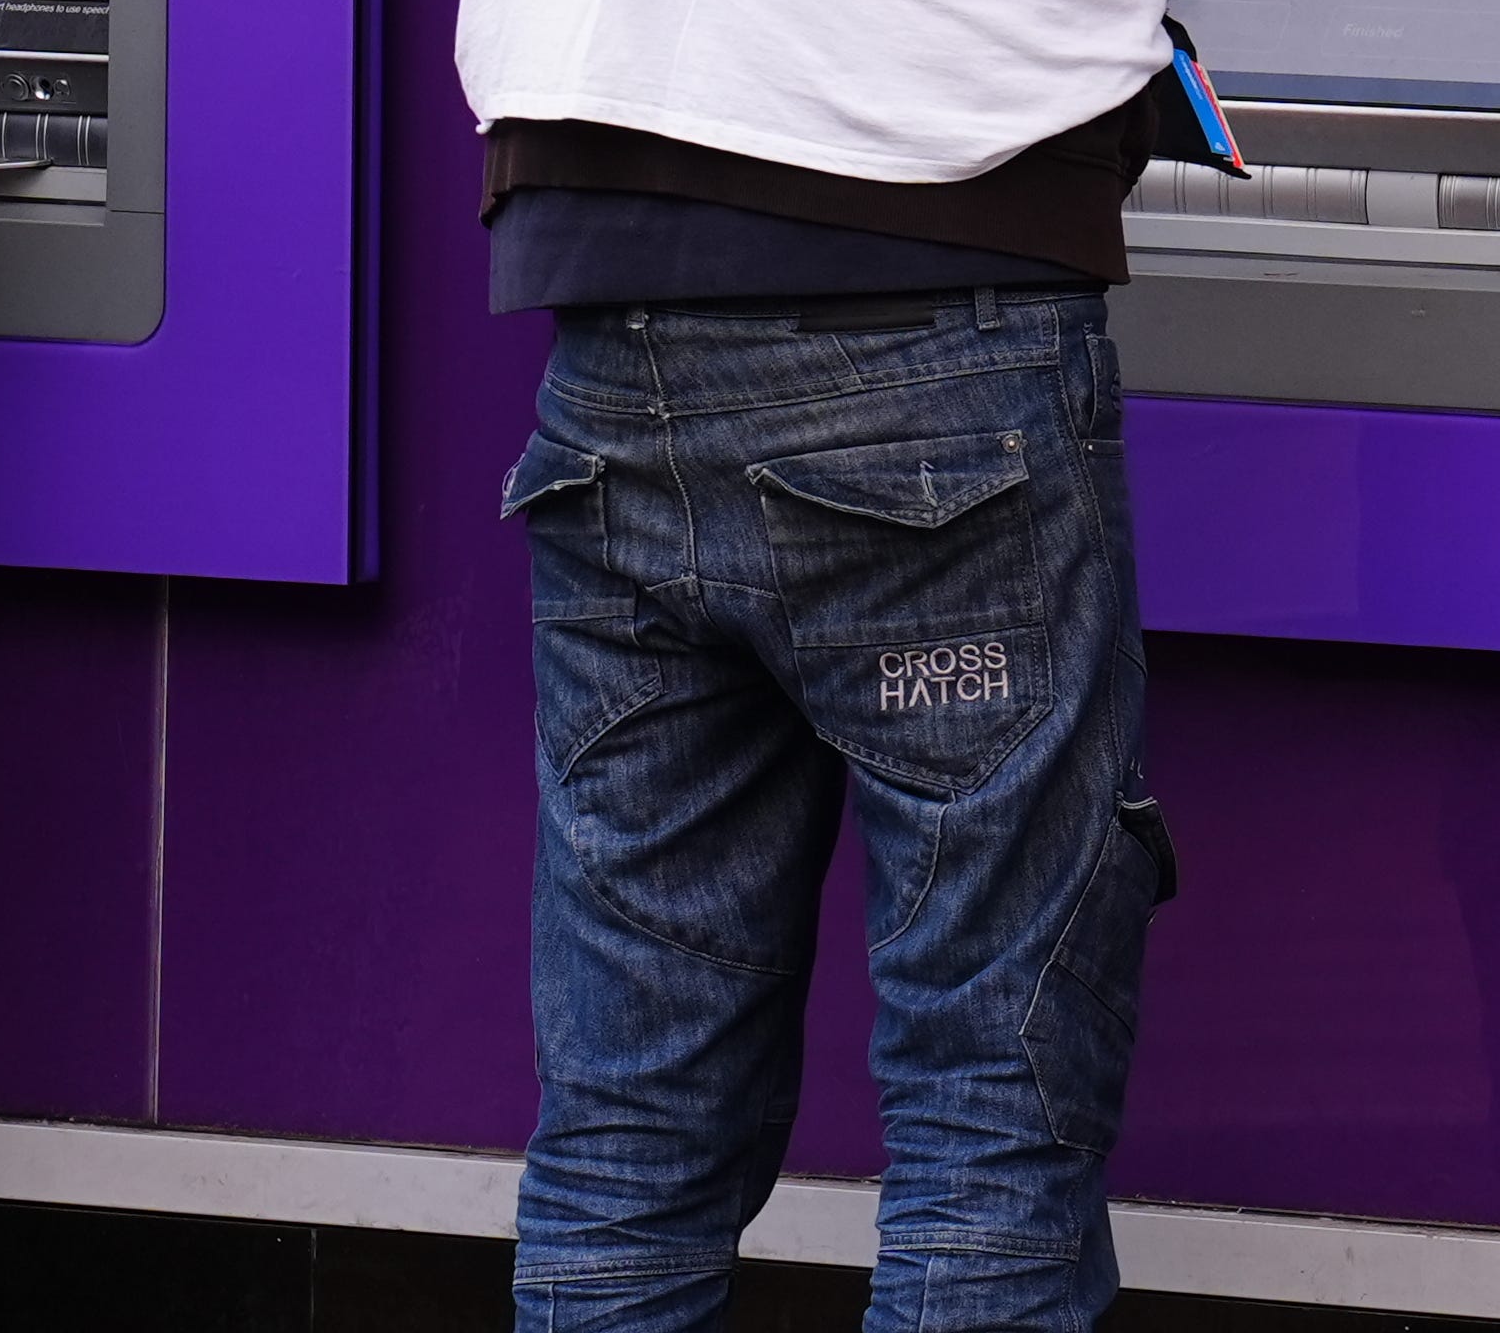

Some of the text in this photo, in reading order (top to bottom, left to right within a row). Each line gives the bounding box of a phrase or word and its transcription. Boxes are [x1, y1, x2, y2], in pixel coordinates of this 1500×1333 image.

[5, 2, 55, 13] headphones
[55, 4, 65, 13] to
[65, 6, 81, 14] use
[1343, 23, 1404, 39] Finished
[879, 642, 1007, 679] CROSS
[879, 669, 1009, 711] HATCH
